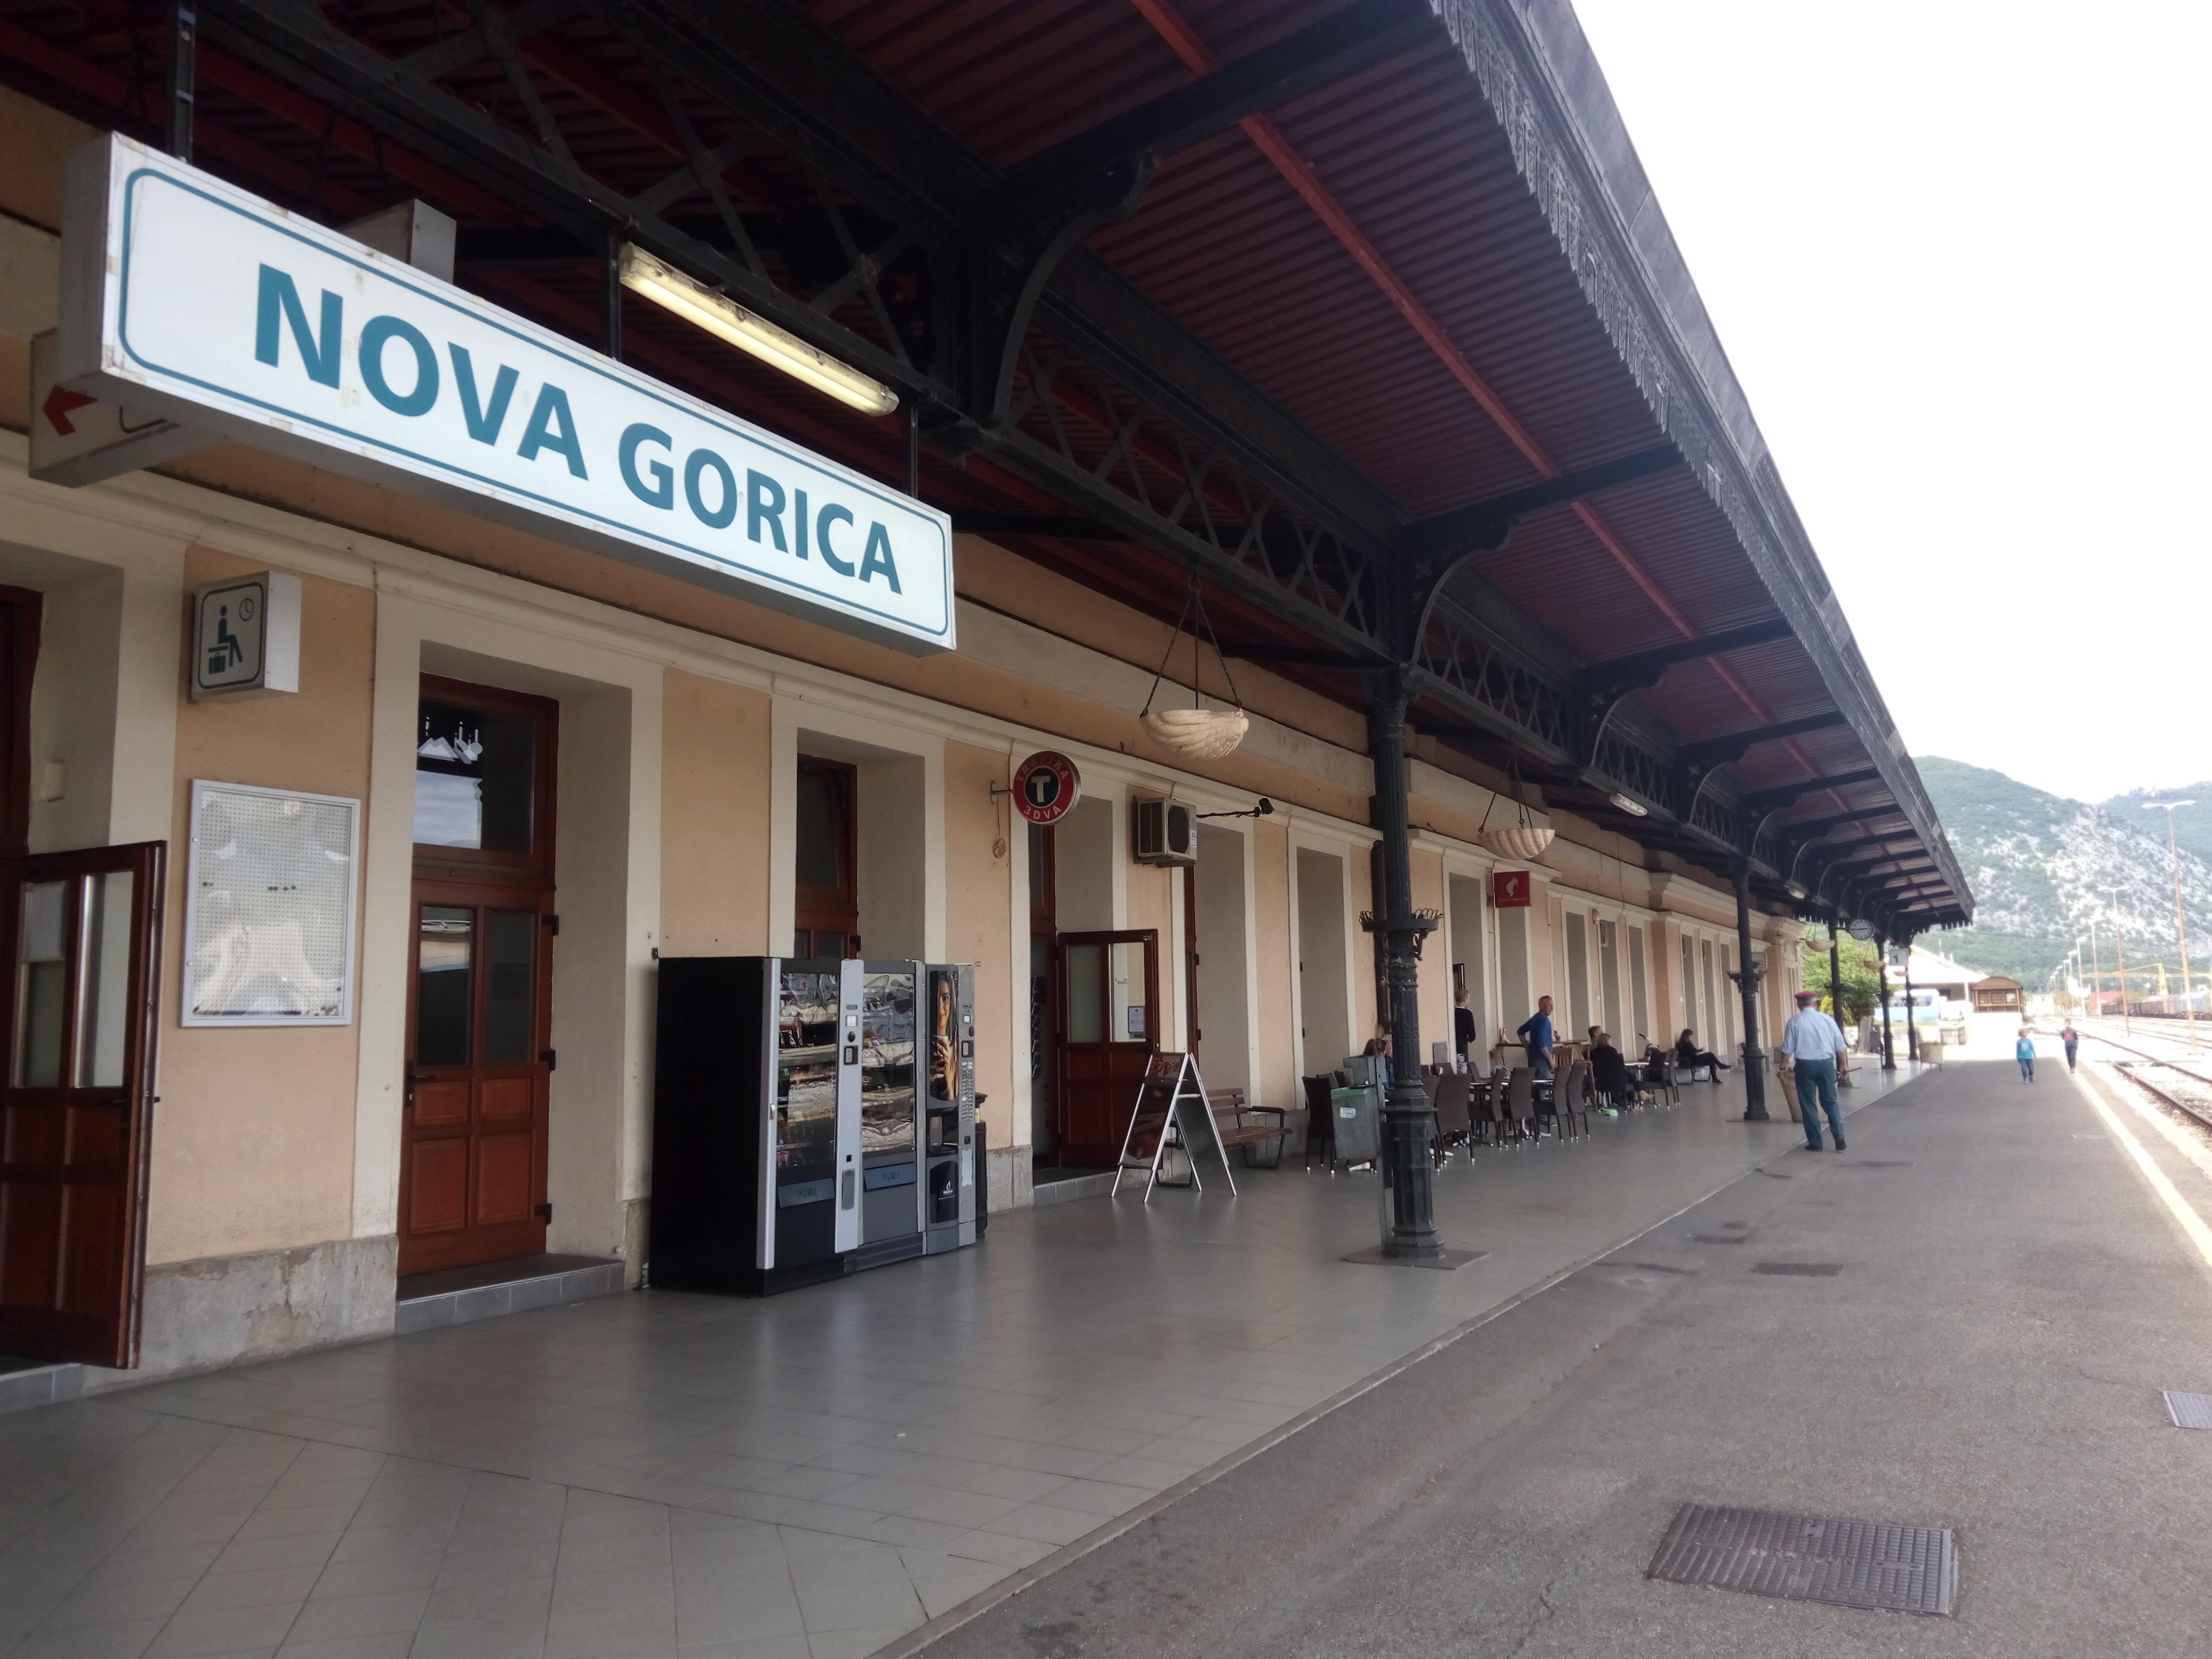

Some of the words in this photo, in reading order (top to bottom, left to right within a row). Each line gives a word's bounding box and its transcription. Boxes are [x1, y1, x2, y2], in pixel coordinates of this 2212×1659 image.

[254, 263, 588, 481] NOVA
[618, 422, 902, 596] GORICA
[1017, 756, 1068, 781] TRAFIKA
[1032, 775, 1051, 803] T
